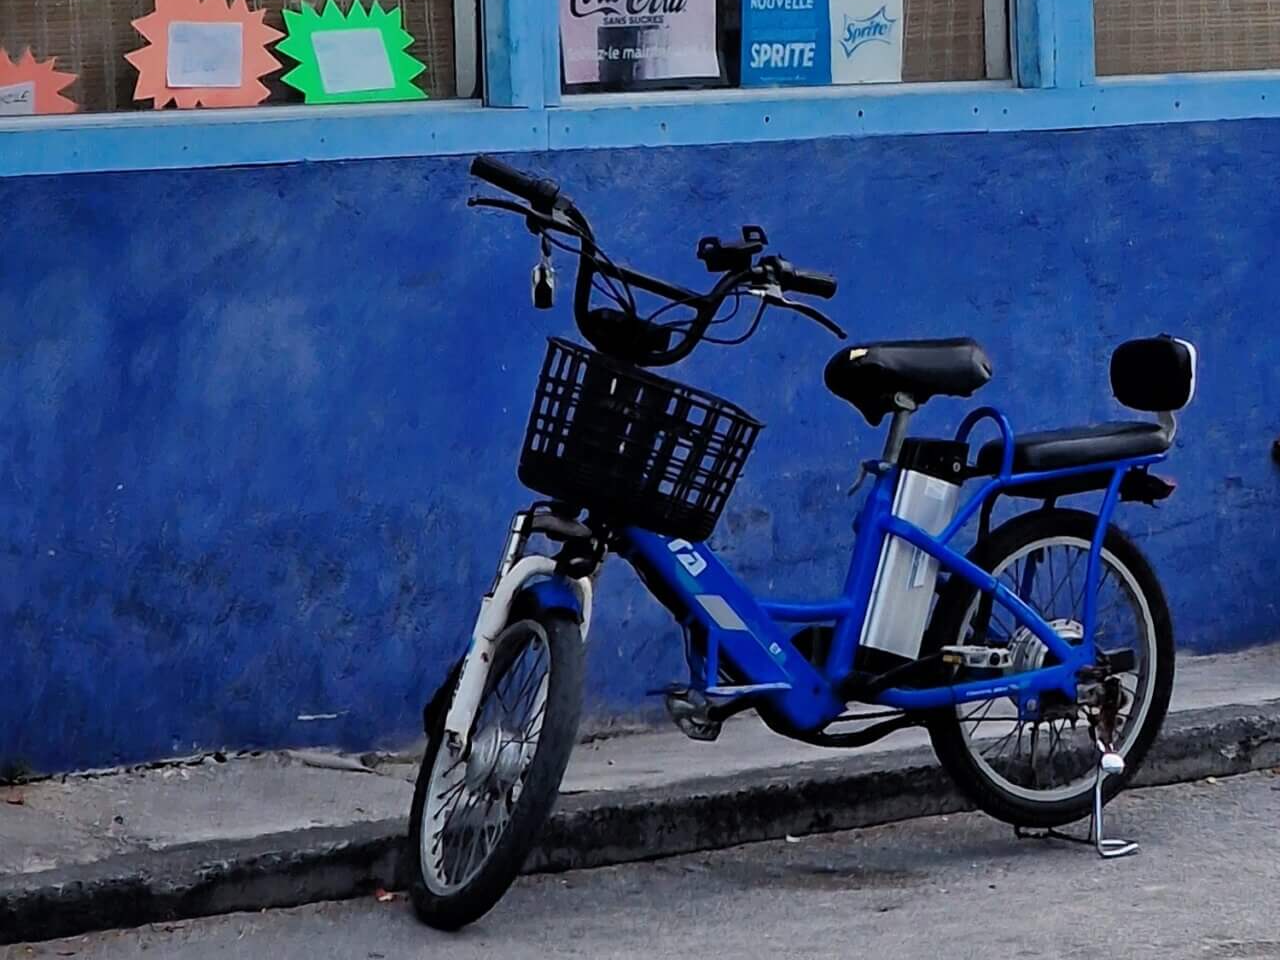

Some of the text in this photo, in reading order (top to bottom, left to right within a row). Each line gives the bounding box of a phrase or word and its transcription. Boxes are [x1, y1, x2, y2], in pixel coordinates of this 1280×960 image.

[603, 15, 664, 25] SANS SUCRES
[843, 21, 889, 43] Sprite
[750, 42, 816, 69] SPRITE
